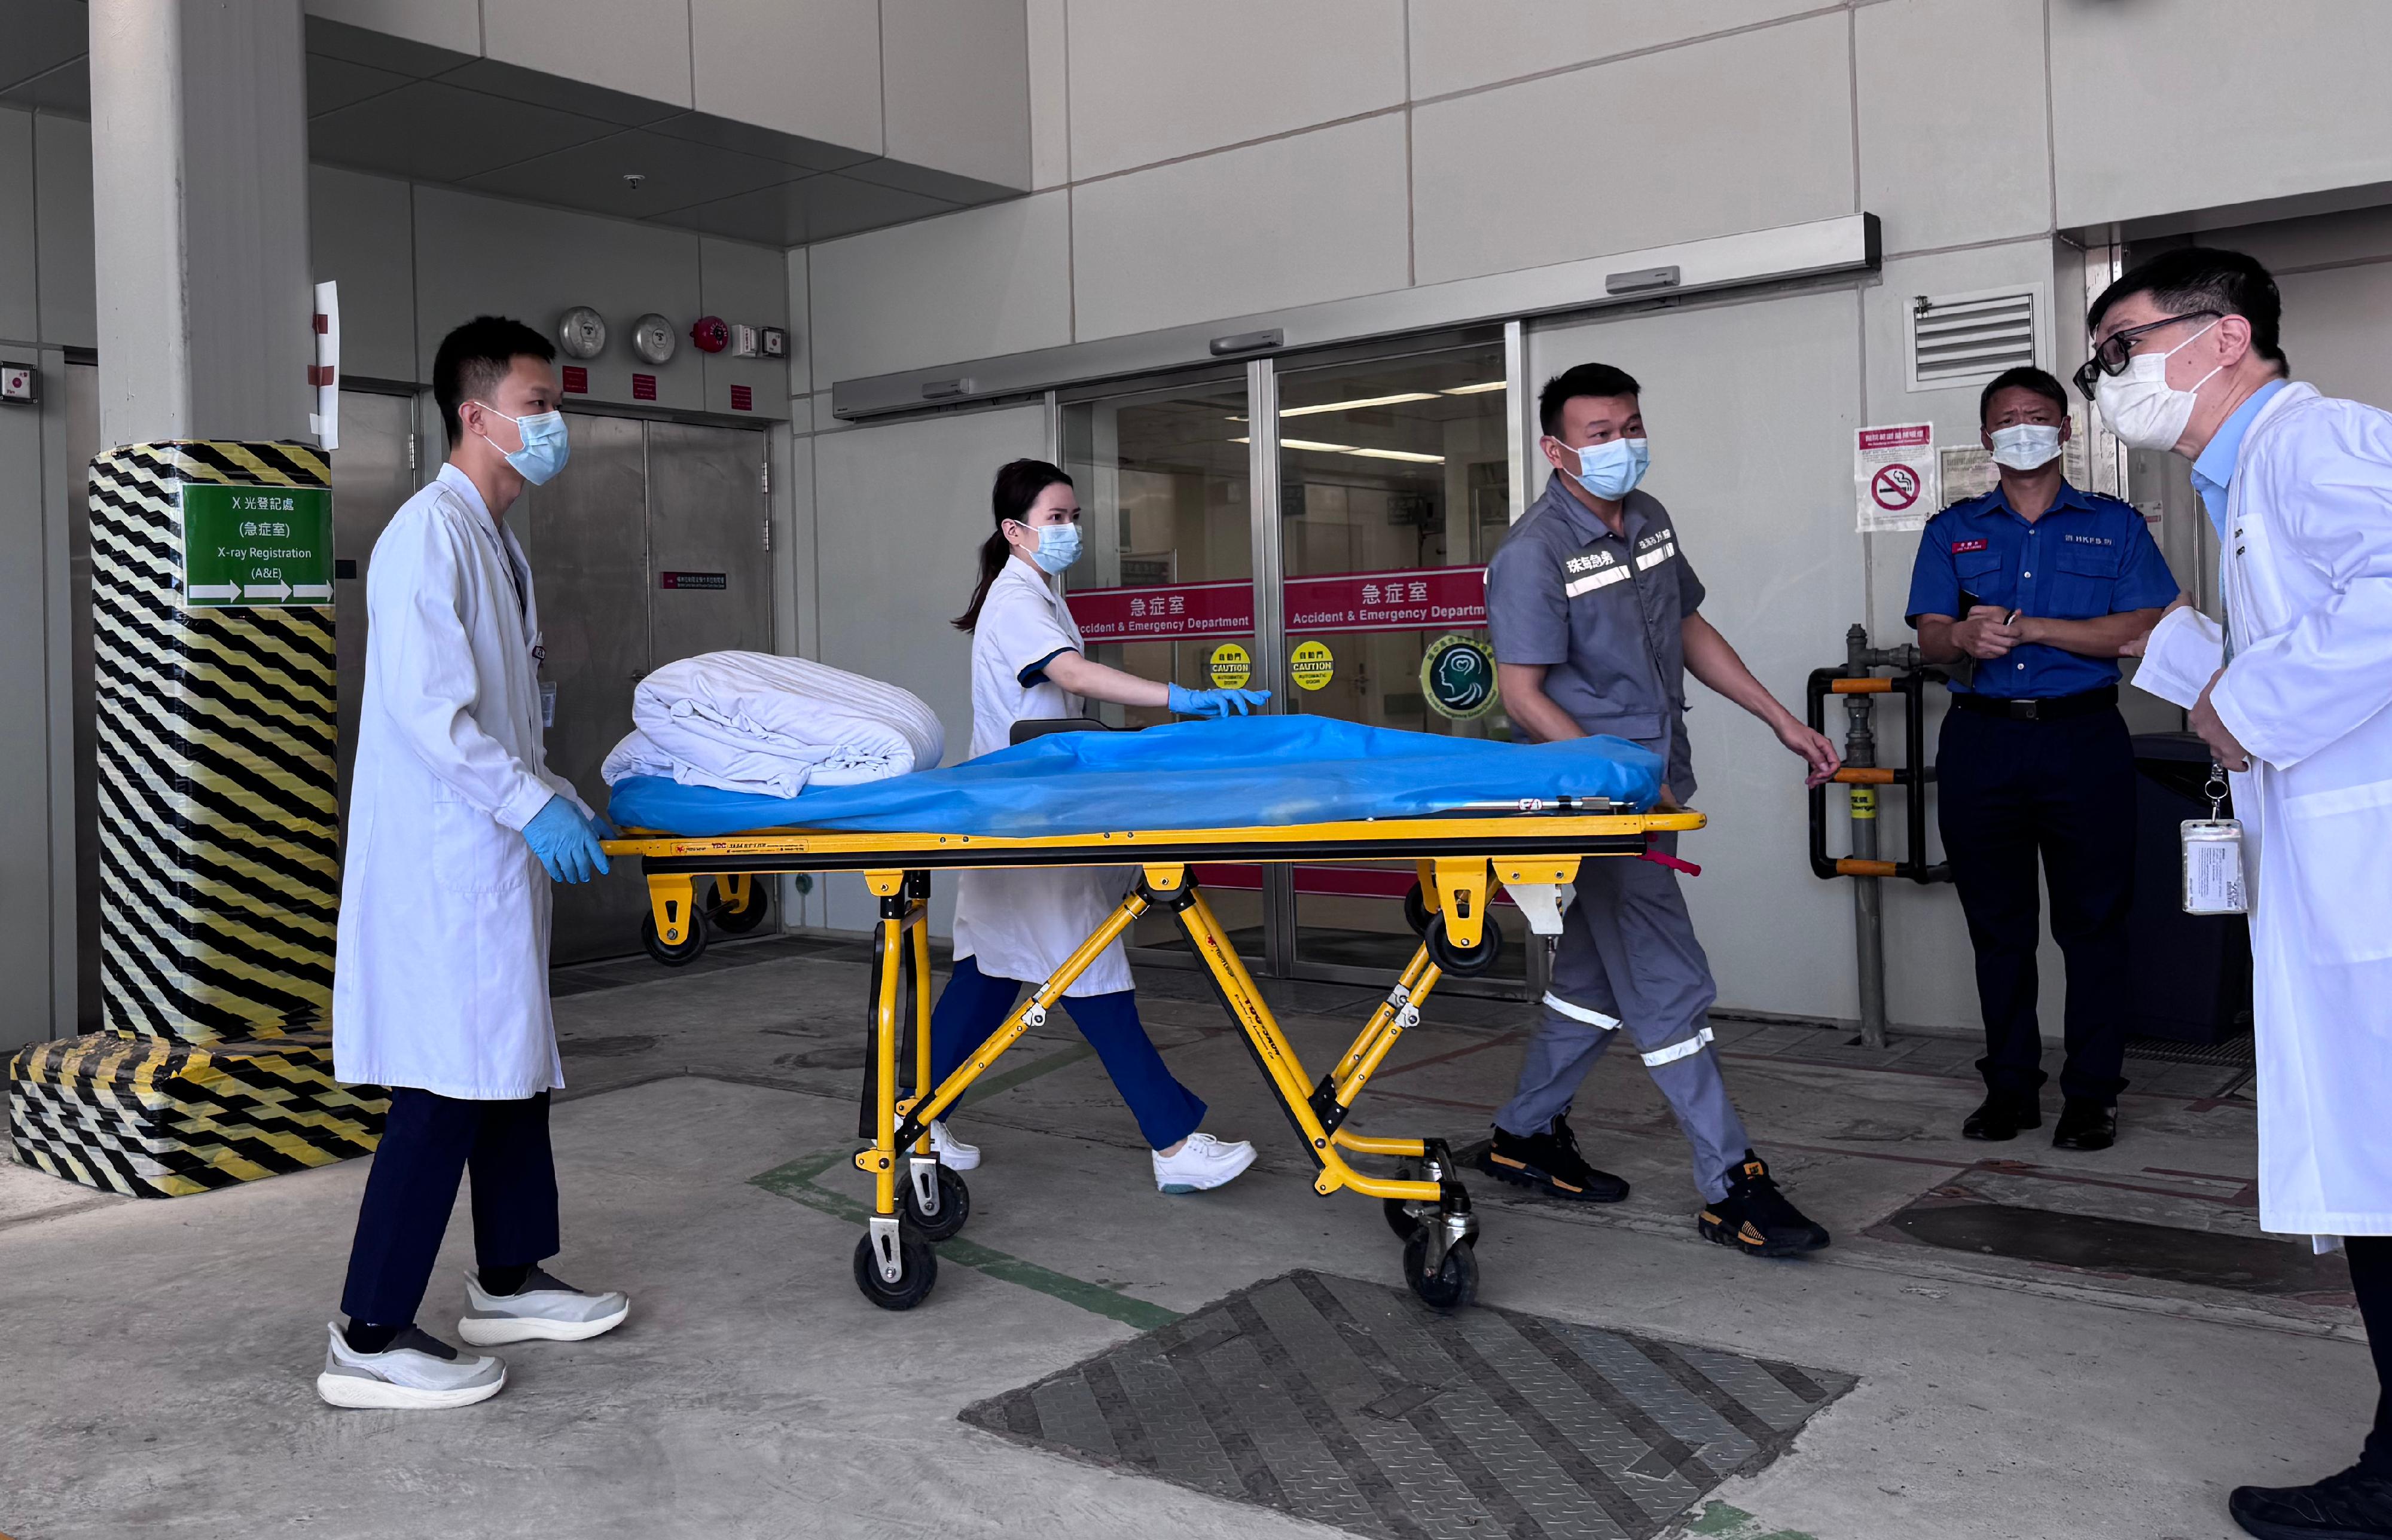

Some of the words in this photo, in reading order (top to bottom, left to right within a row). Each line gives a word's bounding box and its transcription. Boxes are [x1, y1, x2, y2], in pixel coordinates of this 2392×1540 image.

[245, 497, 294, 511] 光登記處
[239, 521, 290, 537] (急症室)
[218, 547, 247, 560] X-ray
[250, 547, 312, 560] Registration
[251, 568, 282, 579] (A&E)
[1362, 581, 1428, 604] 急症室
[1130, 595, 1185, 616] 急症室
[1293, 612, 1344, 624] Accident
[1347, 610, 1355, 621] &
[1359, 607, 1427, 622] Emergency
[1431, 605, 1484, 618] Departm
[1076, 623, 1115, 634] ccident
[1118, 622, 1125, 631] &
[1128, 620, 1185, 632] Emergency
[1188, 616, 1249, 629] Department
